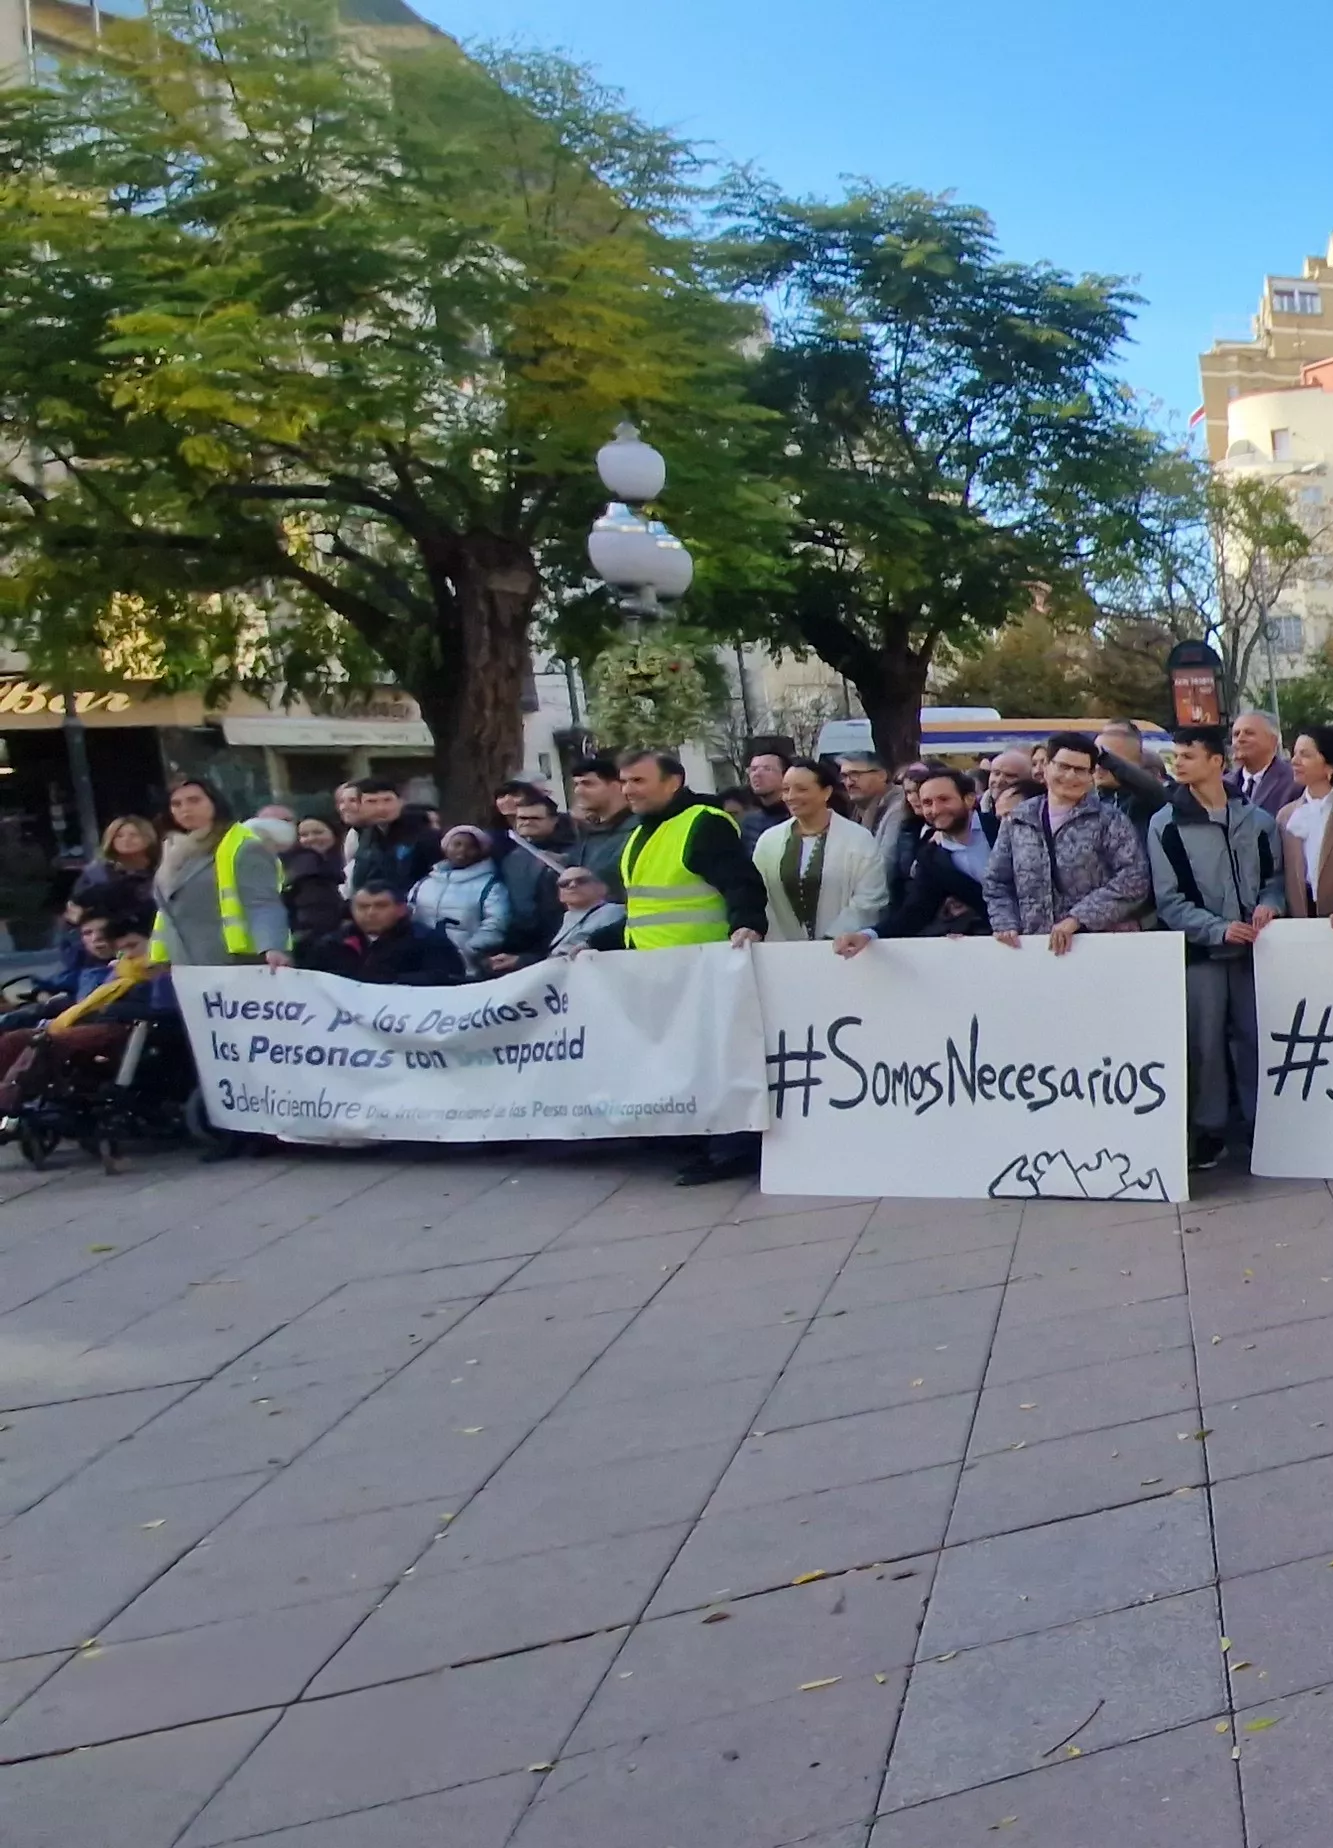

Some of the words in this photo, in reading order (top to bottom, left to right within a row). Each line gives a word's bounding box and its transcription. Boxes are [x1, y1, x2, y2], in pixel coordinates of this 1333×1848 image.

[203, 991, 317, 1025] Huesca,
[544, 984, 569, 1015] de
[248, 1035, 395, 1068] Personas
[405, 1050, 449, 1070] con
[766, 1015, 1166, 1119] #SomosNecesarios
[218, 1078, 236, 1110] 3
